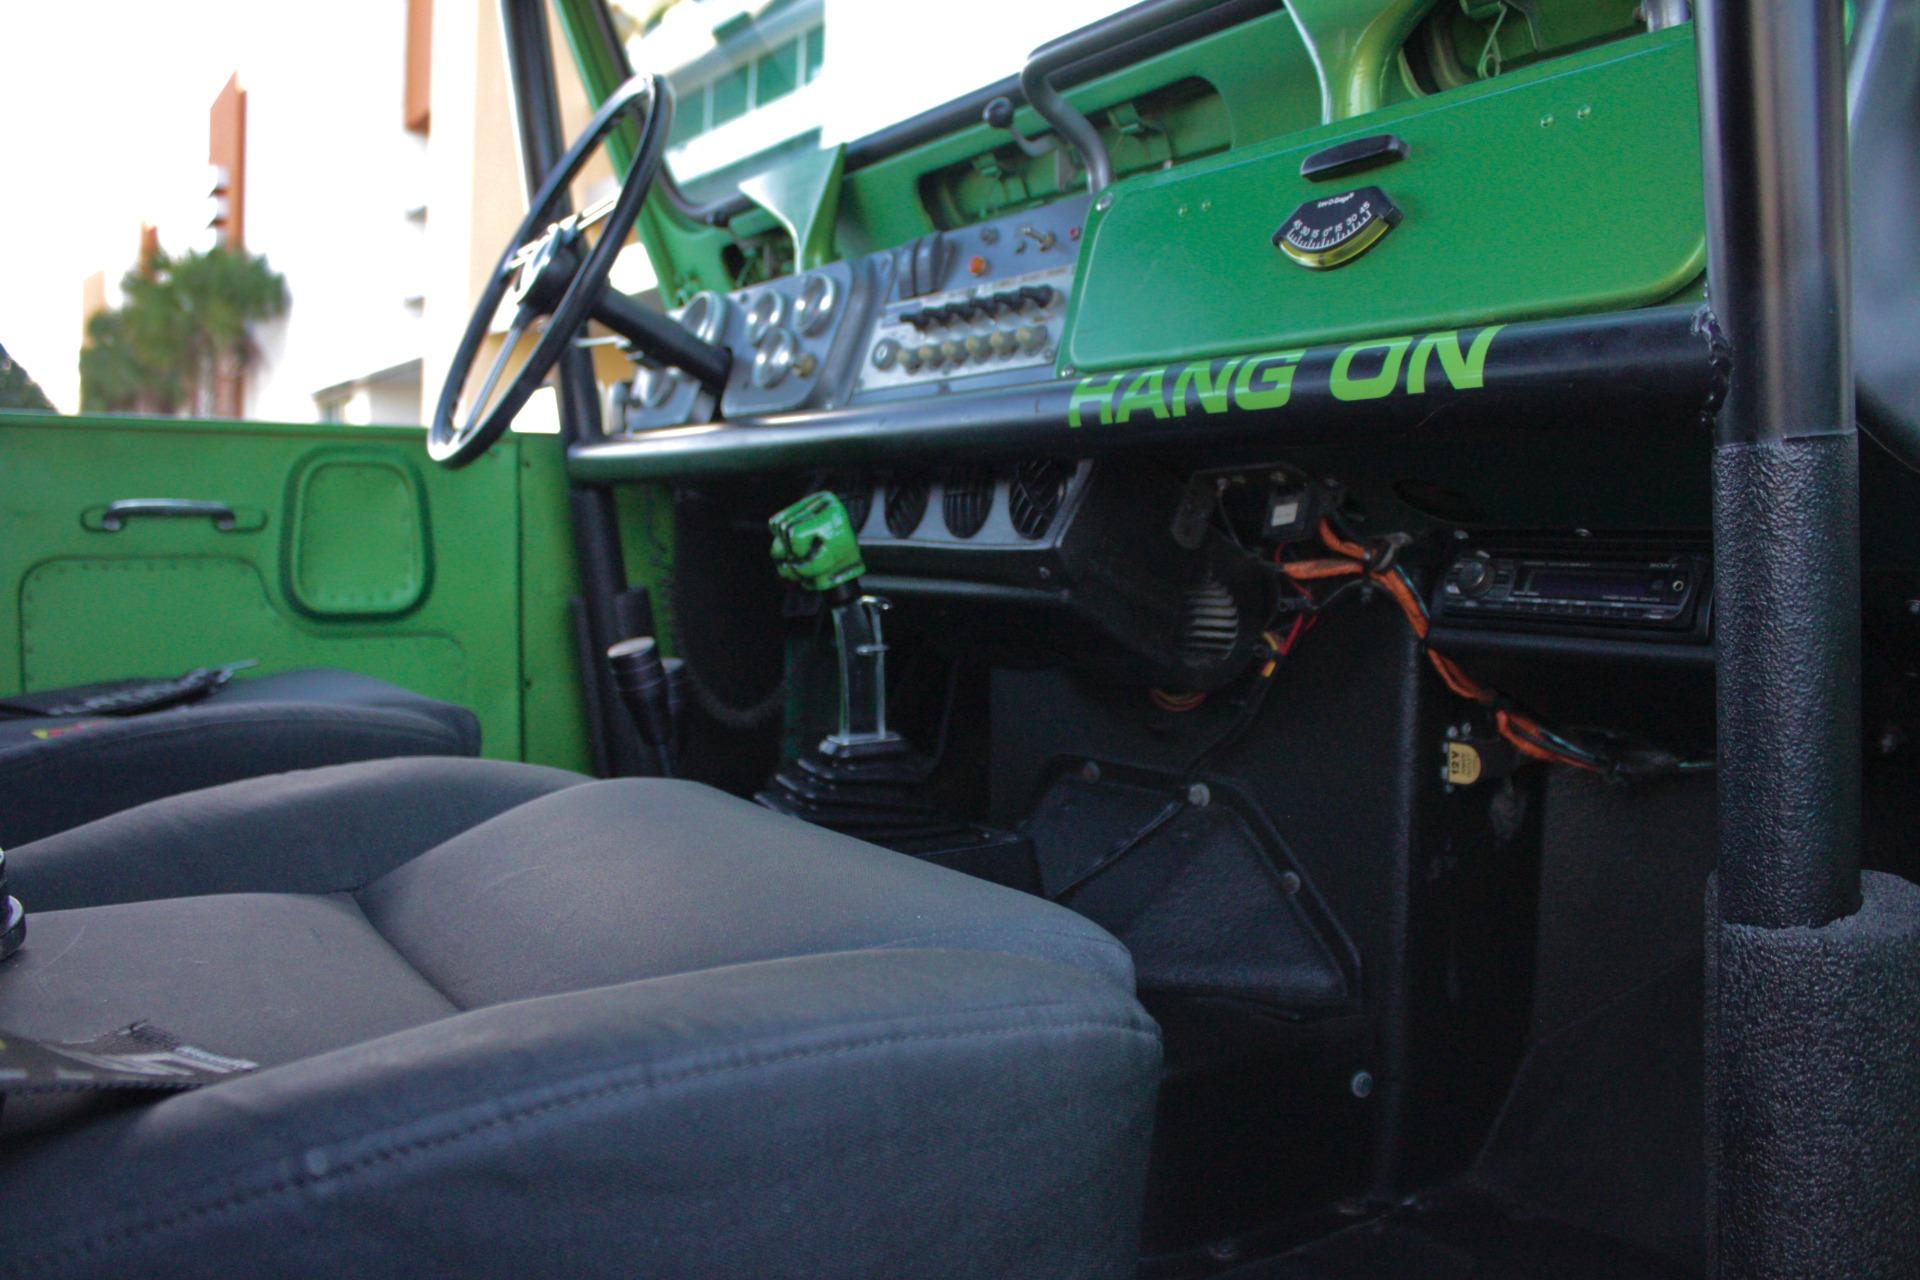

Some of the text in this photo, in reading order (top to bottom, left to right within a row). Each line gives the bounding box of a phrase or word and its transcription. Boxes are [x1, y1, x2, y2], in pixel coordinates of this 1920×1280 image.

[1311, 230, 1320, 238] 15
[1334, 223, 1344, 232] 15
[1346, 213, 1358, 226] 30
[1359, 200, 1371, 214] 45
[1067, 324, 1508, 428] HANG ON
